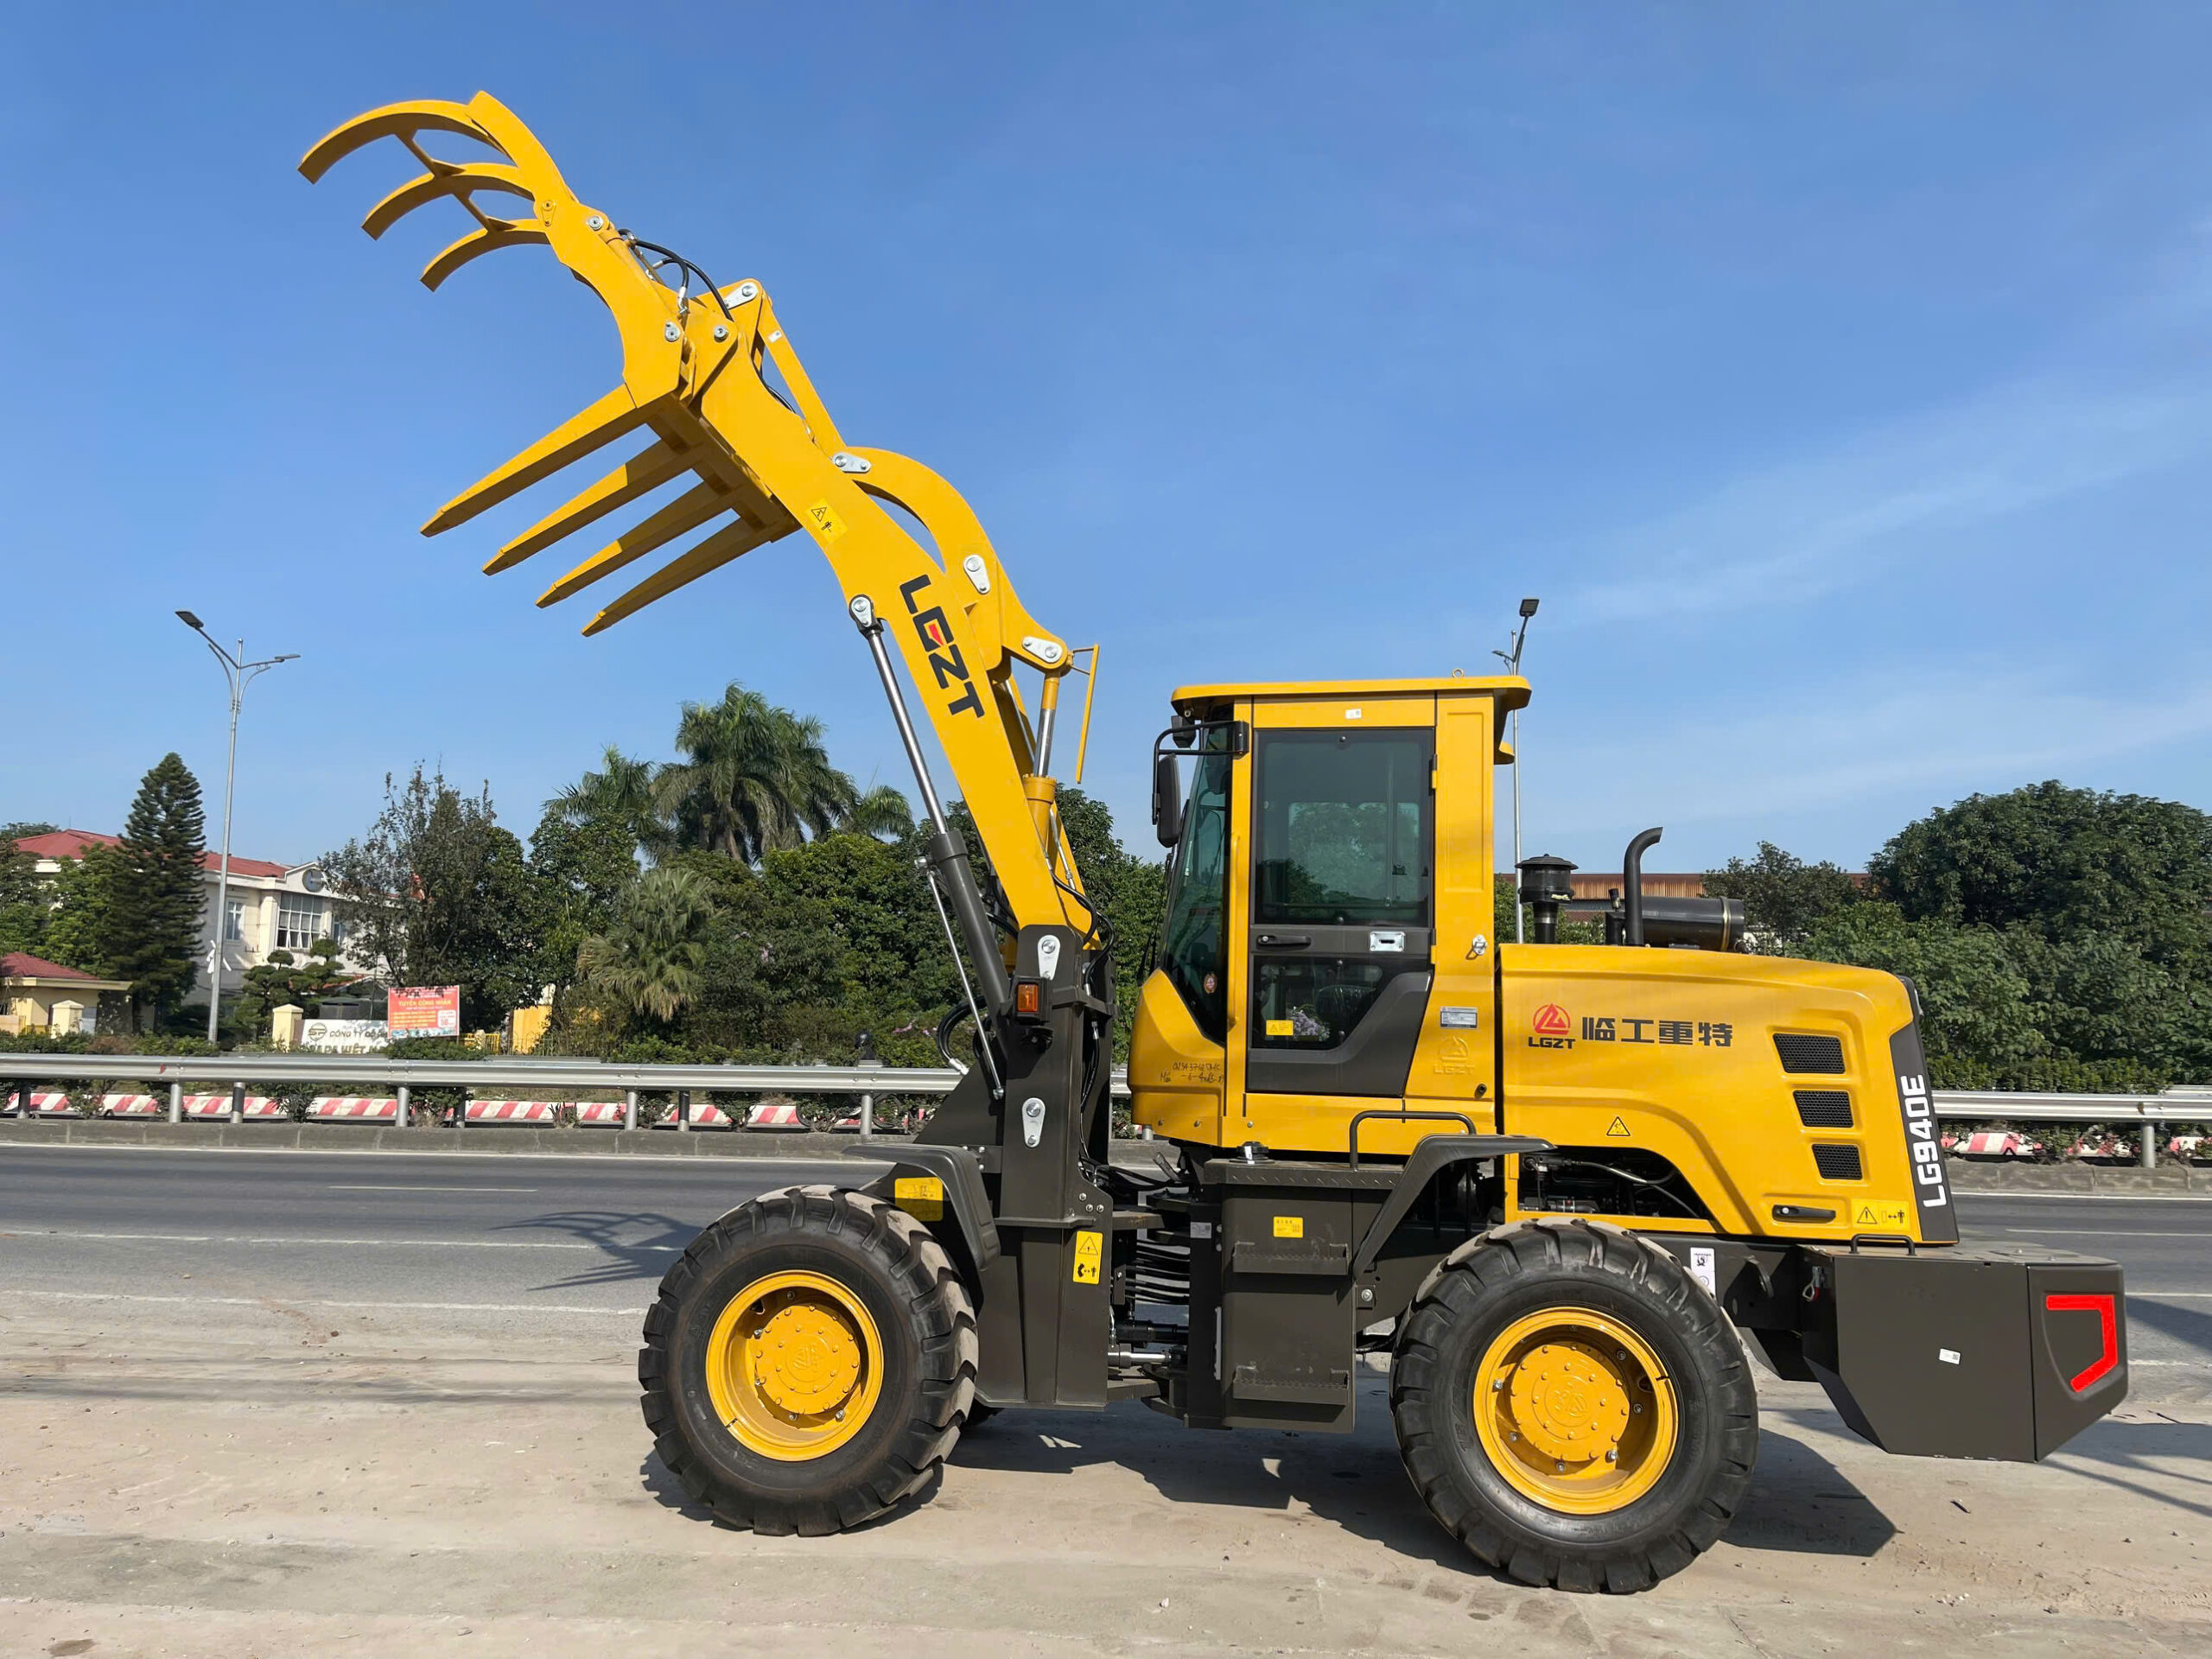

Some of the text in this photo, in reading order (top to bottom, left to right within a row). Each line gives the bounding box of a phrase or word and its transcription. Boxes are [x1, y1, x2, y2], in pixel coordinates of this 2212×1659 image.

[899, 574, 985, 719] LGZT
[1528, 1036, 1576, 1050] LGZT
[1582, 1017, 1732, 1047] 临工重特
[1900, 1074, 1947, 1208] LG940E
